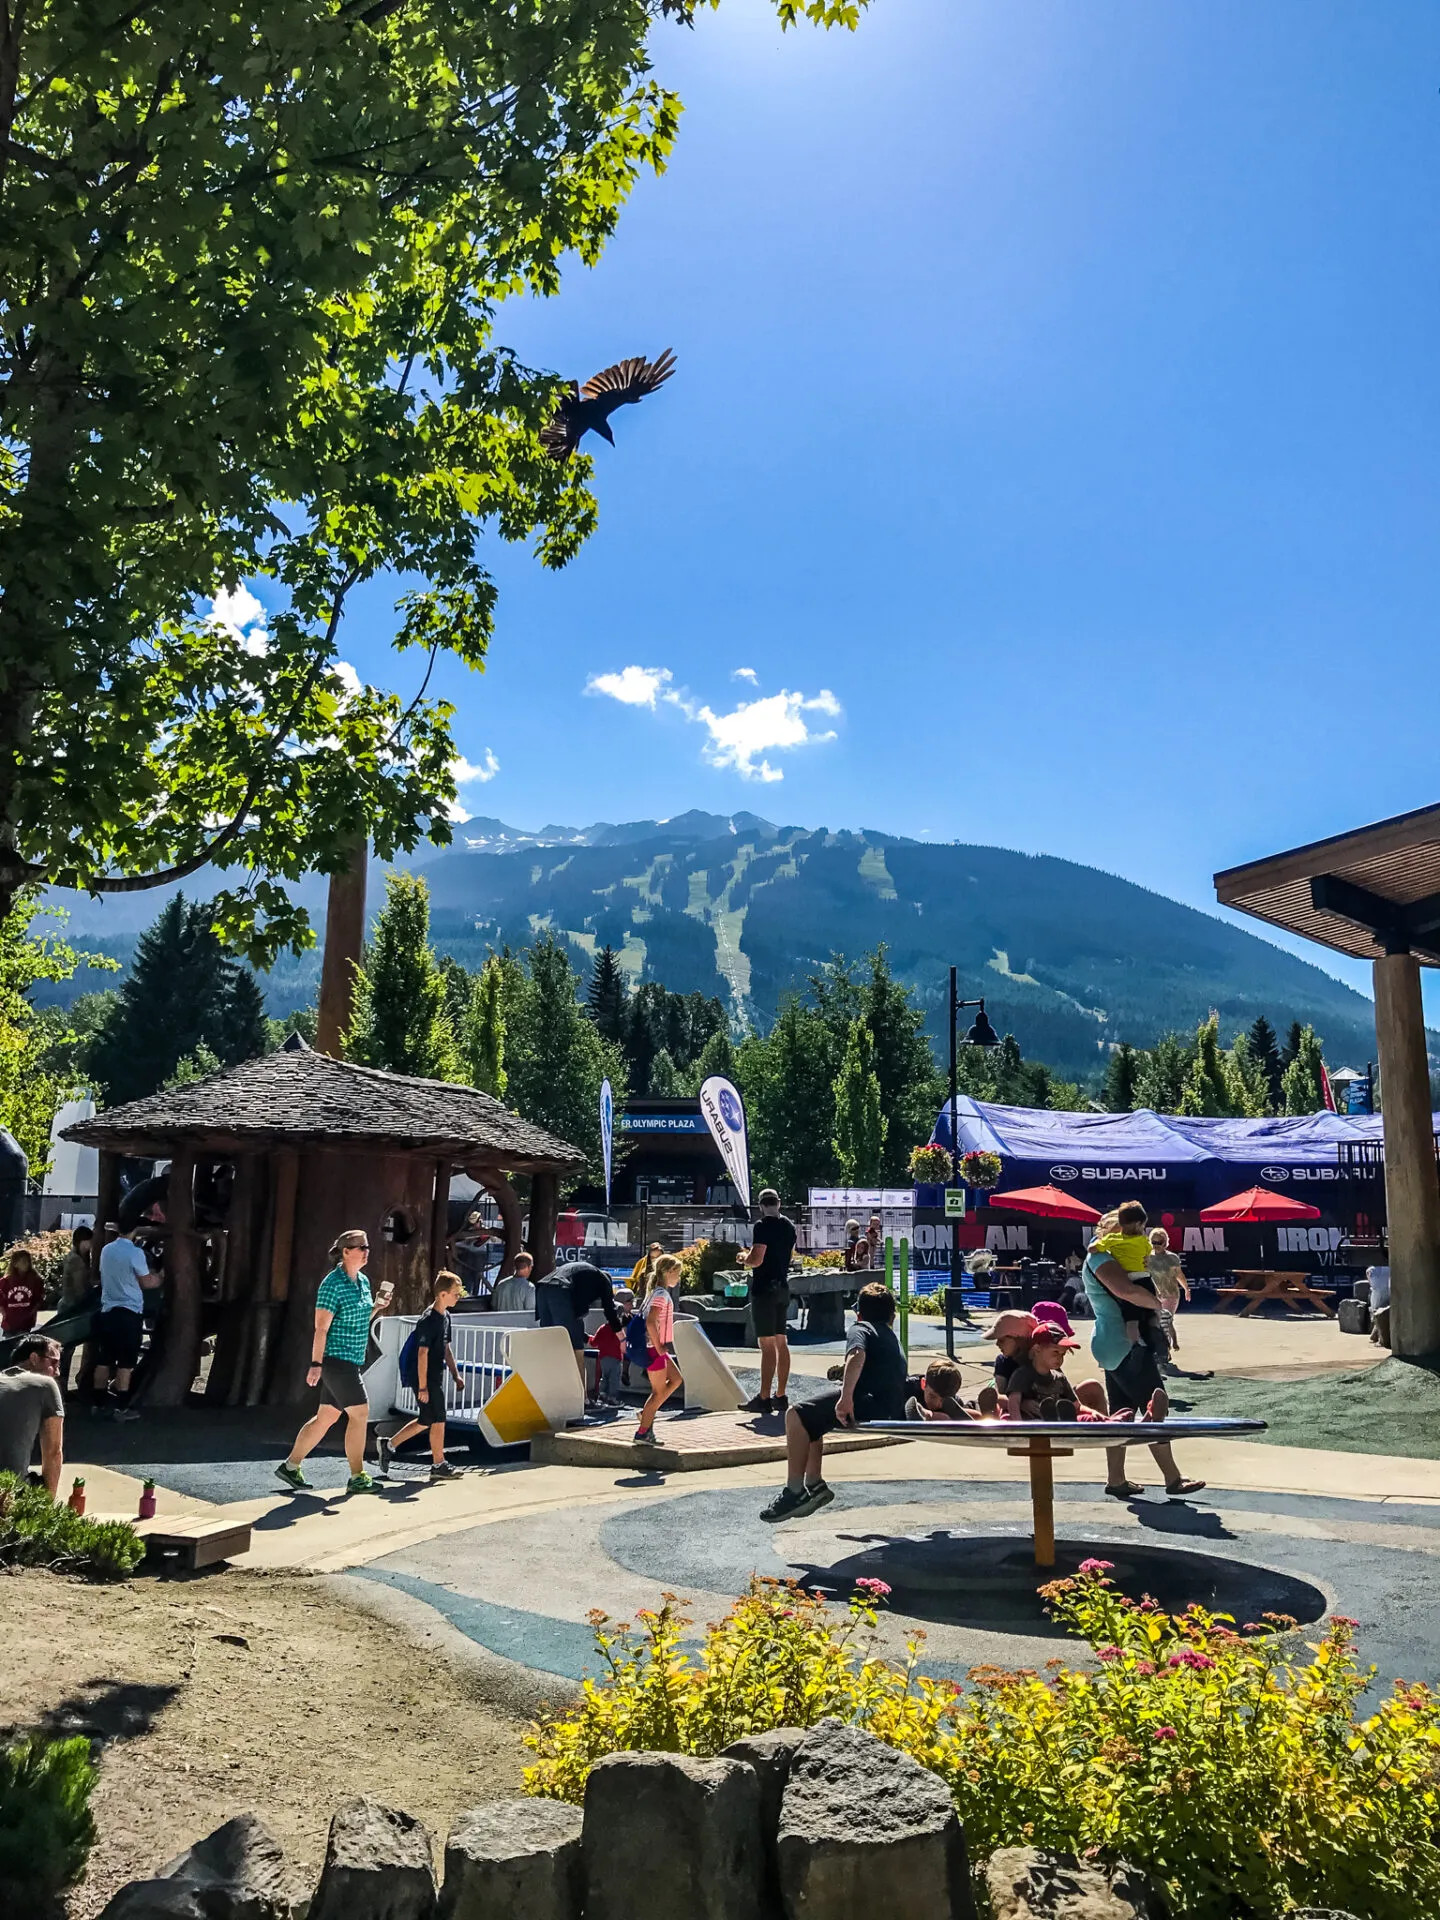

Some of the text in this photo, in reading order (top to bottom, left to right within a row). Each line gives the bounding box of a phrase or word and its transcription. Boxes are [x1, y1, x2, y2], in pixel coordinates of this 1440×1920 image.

[633, 1120, 667, 1128] OLYMPIC
[668, 1120, 695, 1128] PLAZA
[1081, 1168, 1167, 1180] SUBARU
